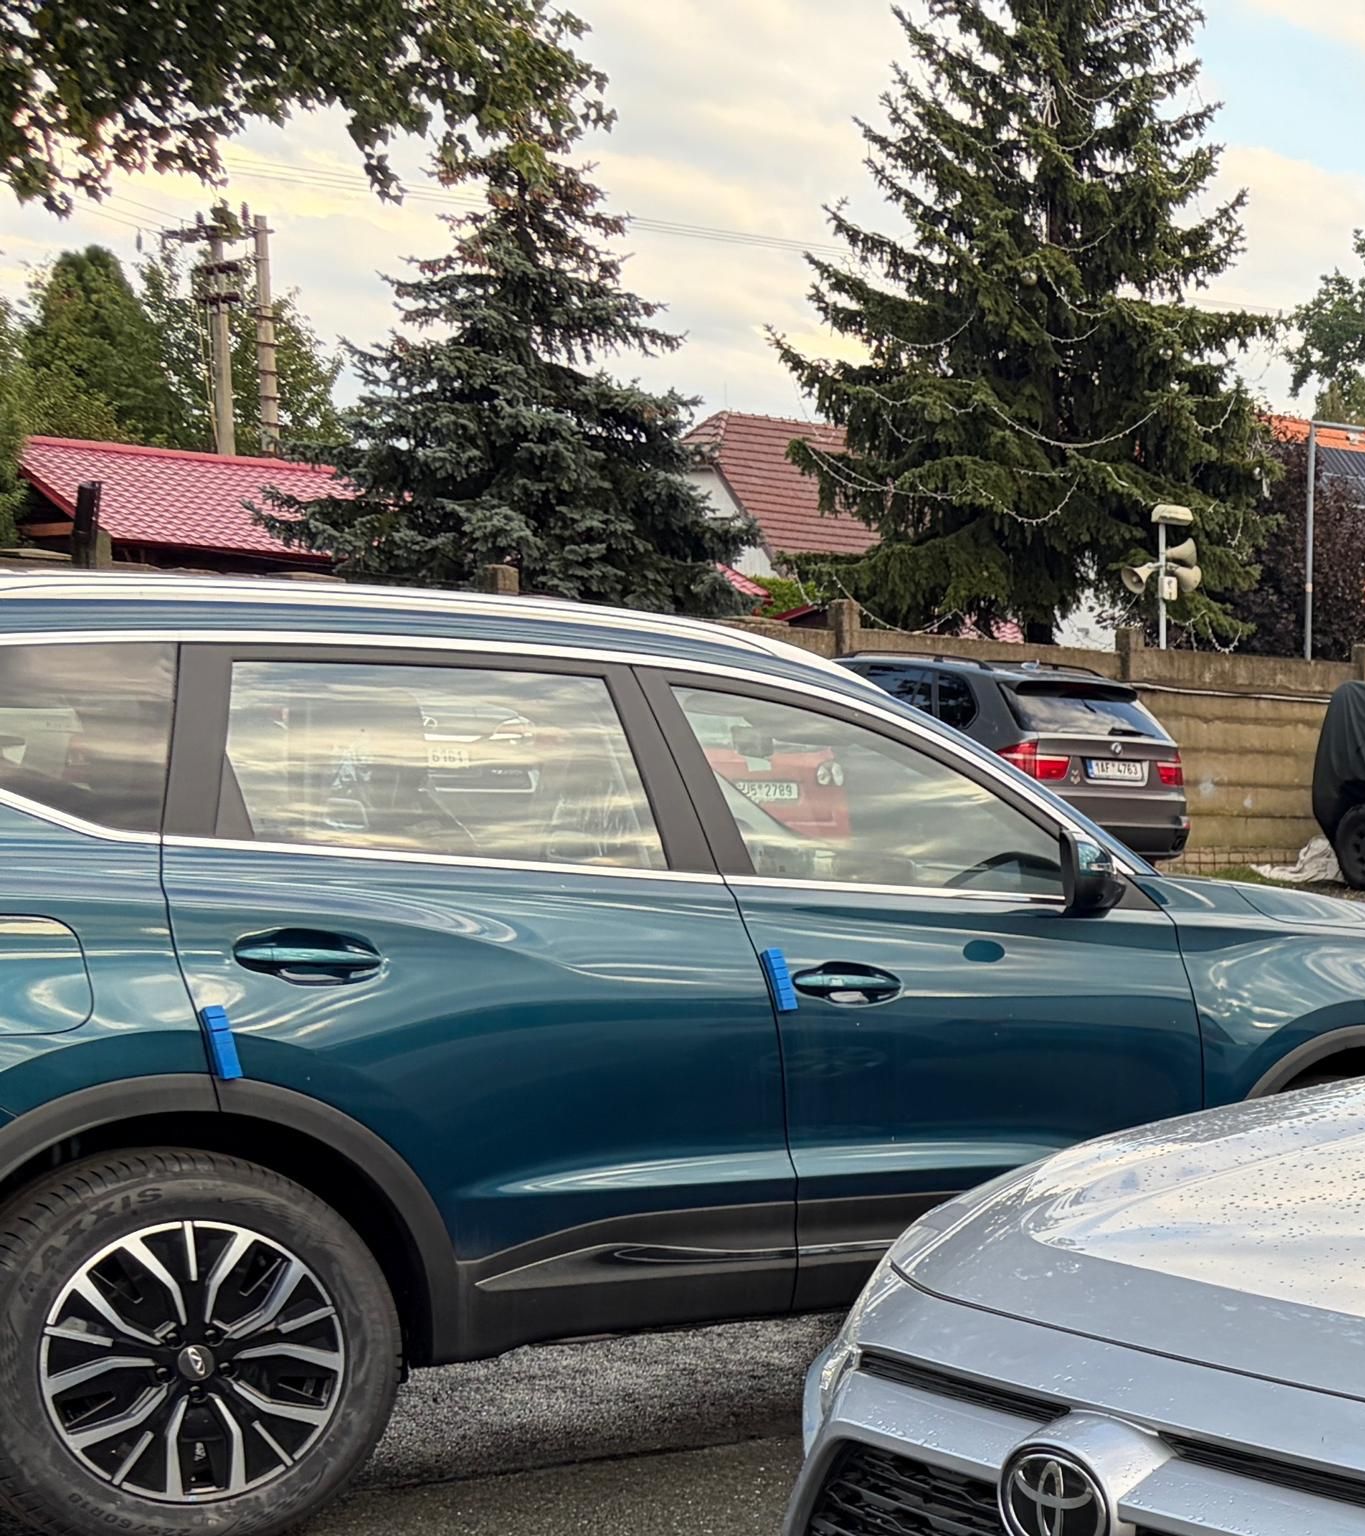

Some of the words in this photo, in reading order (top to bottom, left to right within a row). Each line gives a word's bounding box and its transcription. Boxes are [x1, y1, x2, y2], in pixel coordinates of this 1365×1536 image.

[1095, 761, 1110, 773] 1AF
[1117, 762, 1138, 775] 4763
[18, 1187, 163, 1304] MAXXIS
